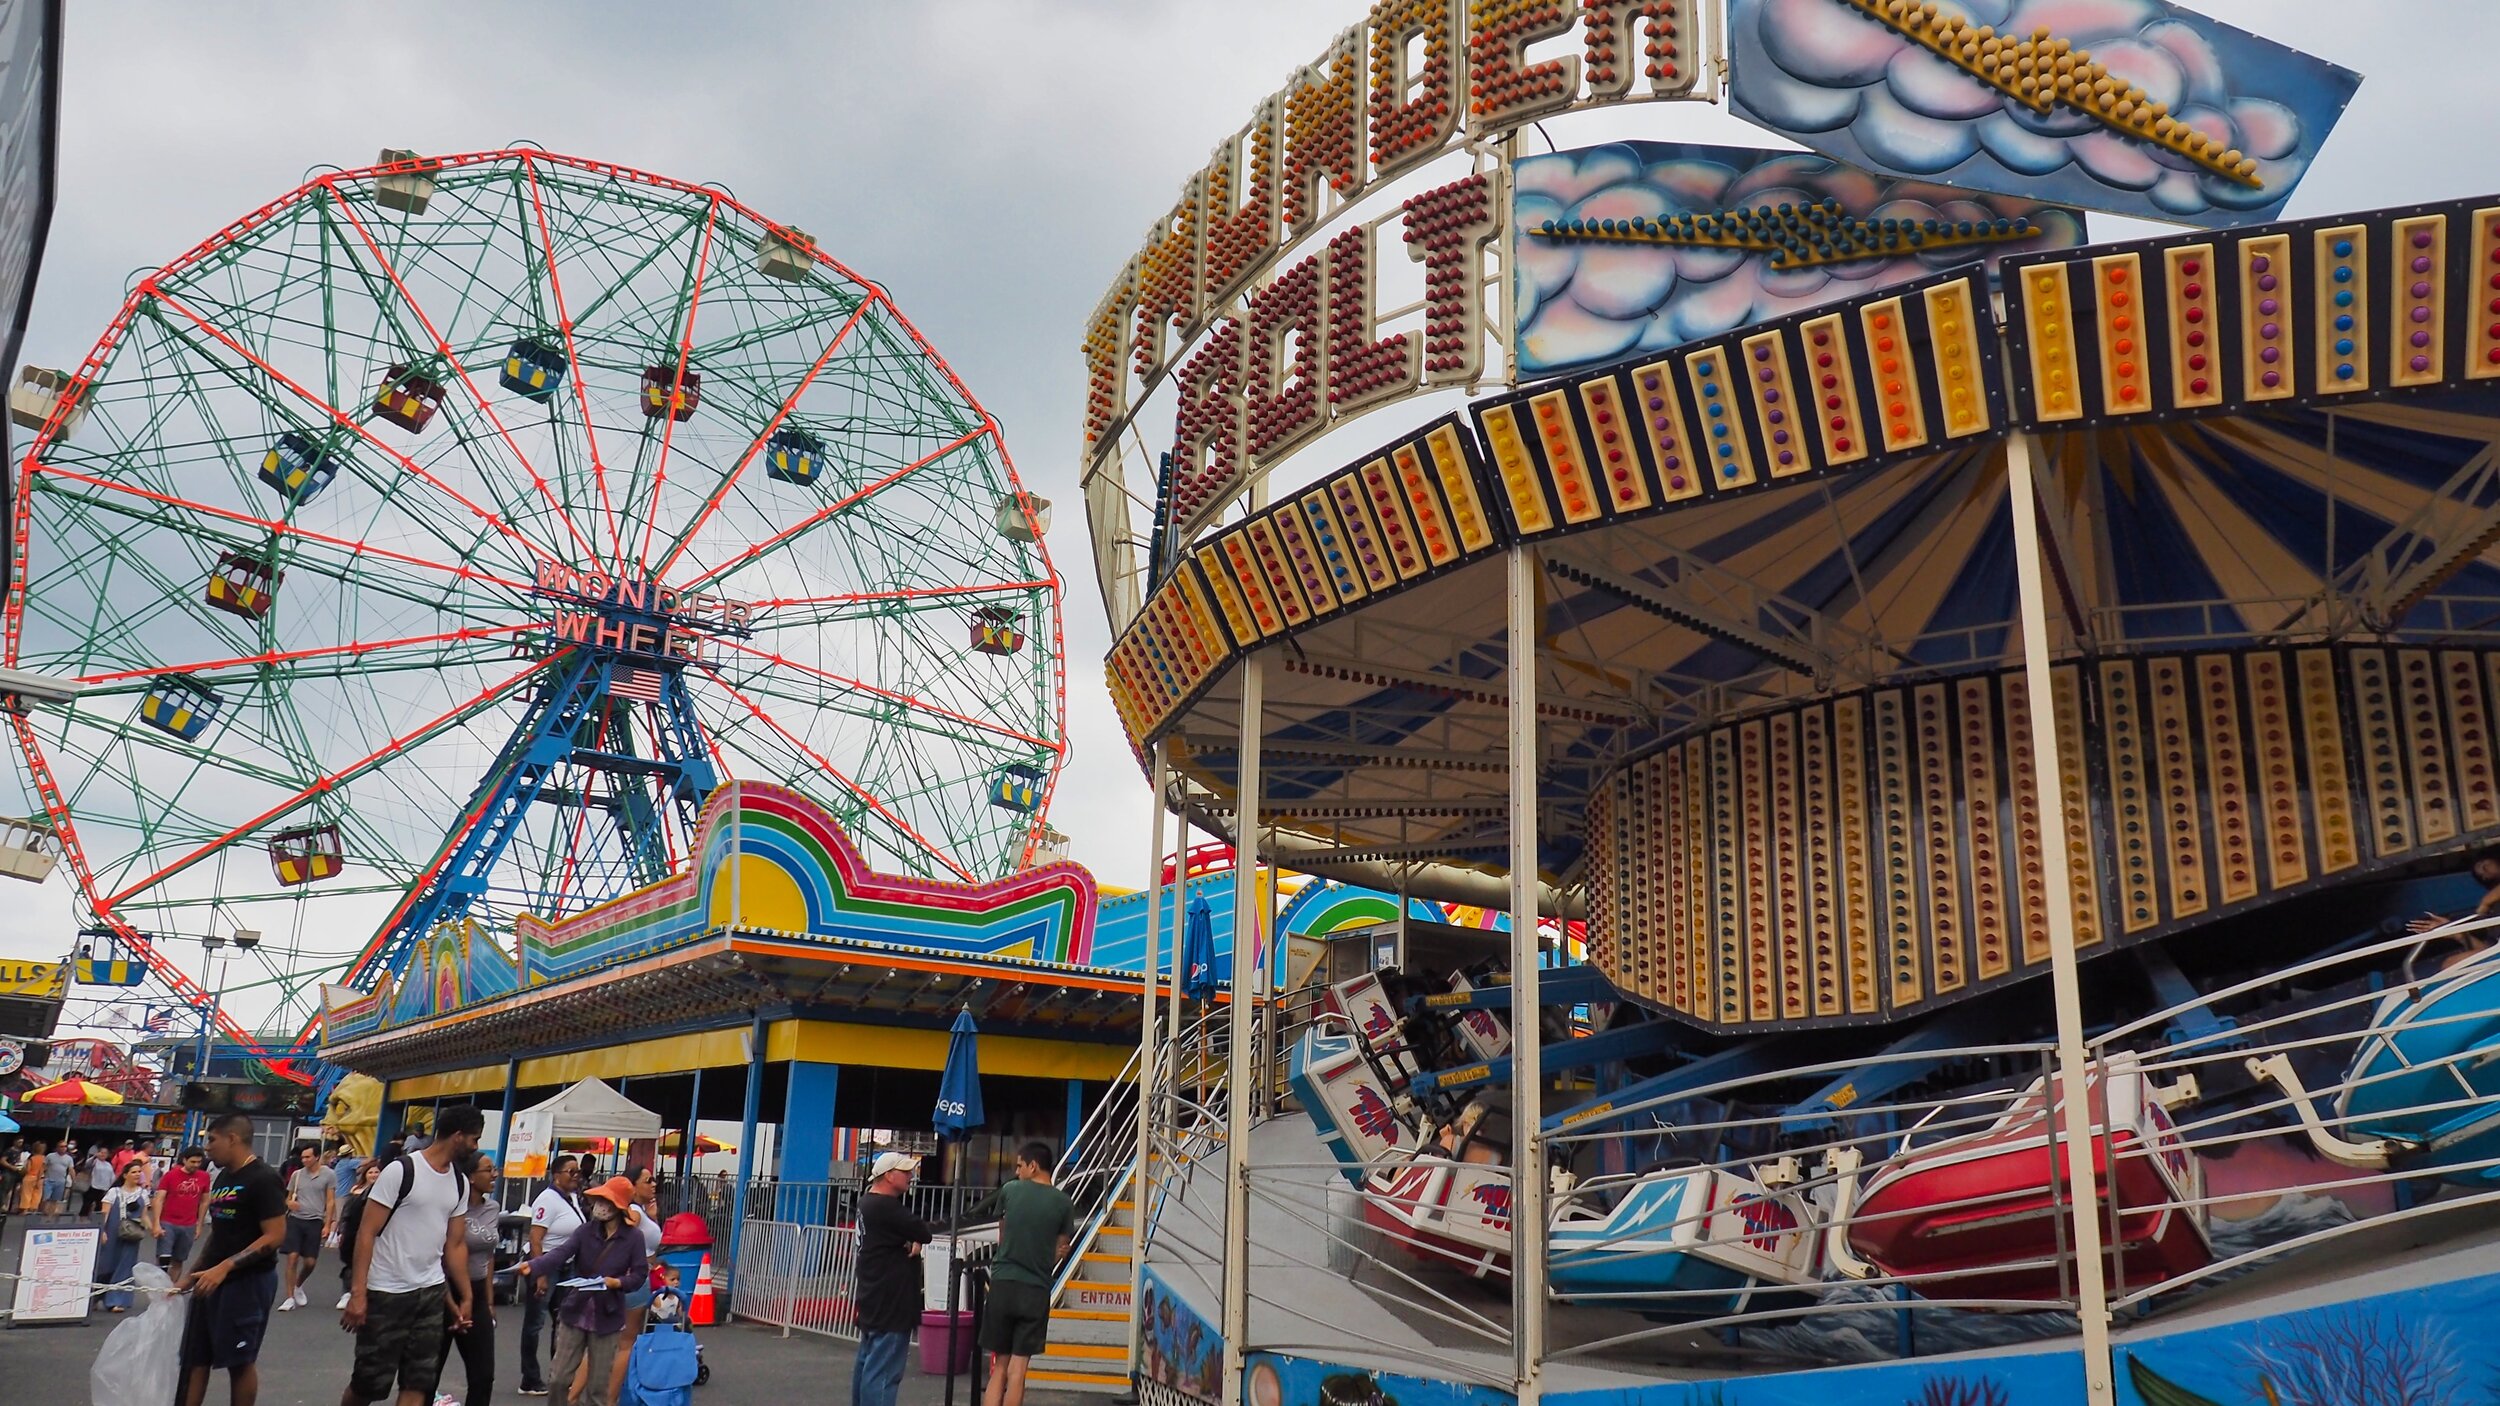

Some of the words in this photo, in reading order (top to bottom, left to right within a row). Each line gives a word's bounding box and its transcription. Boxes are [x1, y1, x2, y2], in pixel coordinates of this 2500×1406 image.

[1173, 165, 1504, 532] BOLT
[536, 558, 752, 629] WONDER
[554, 608, 712, 662] WHEEL
[536, 1207, 545, 1219] 3
[1081, 1291, 1131, 1306] ENTRAN
